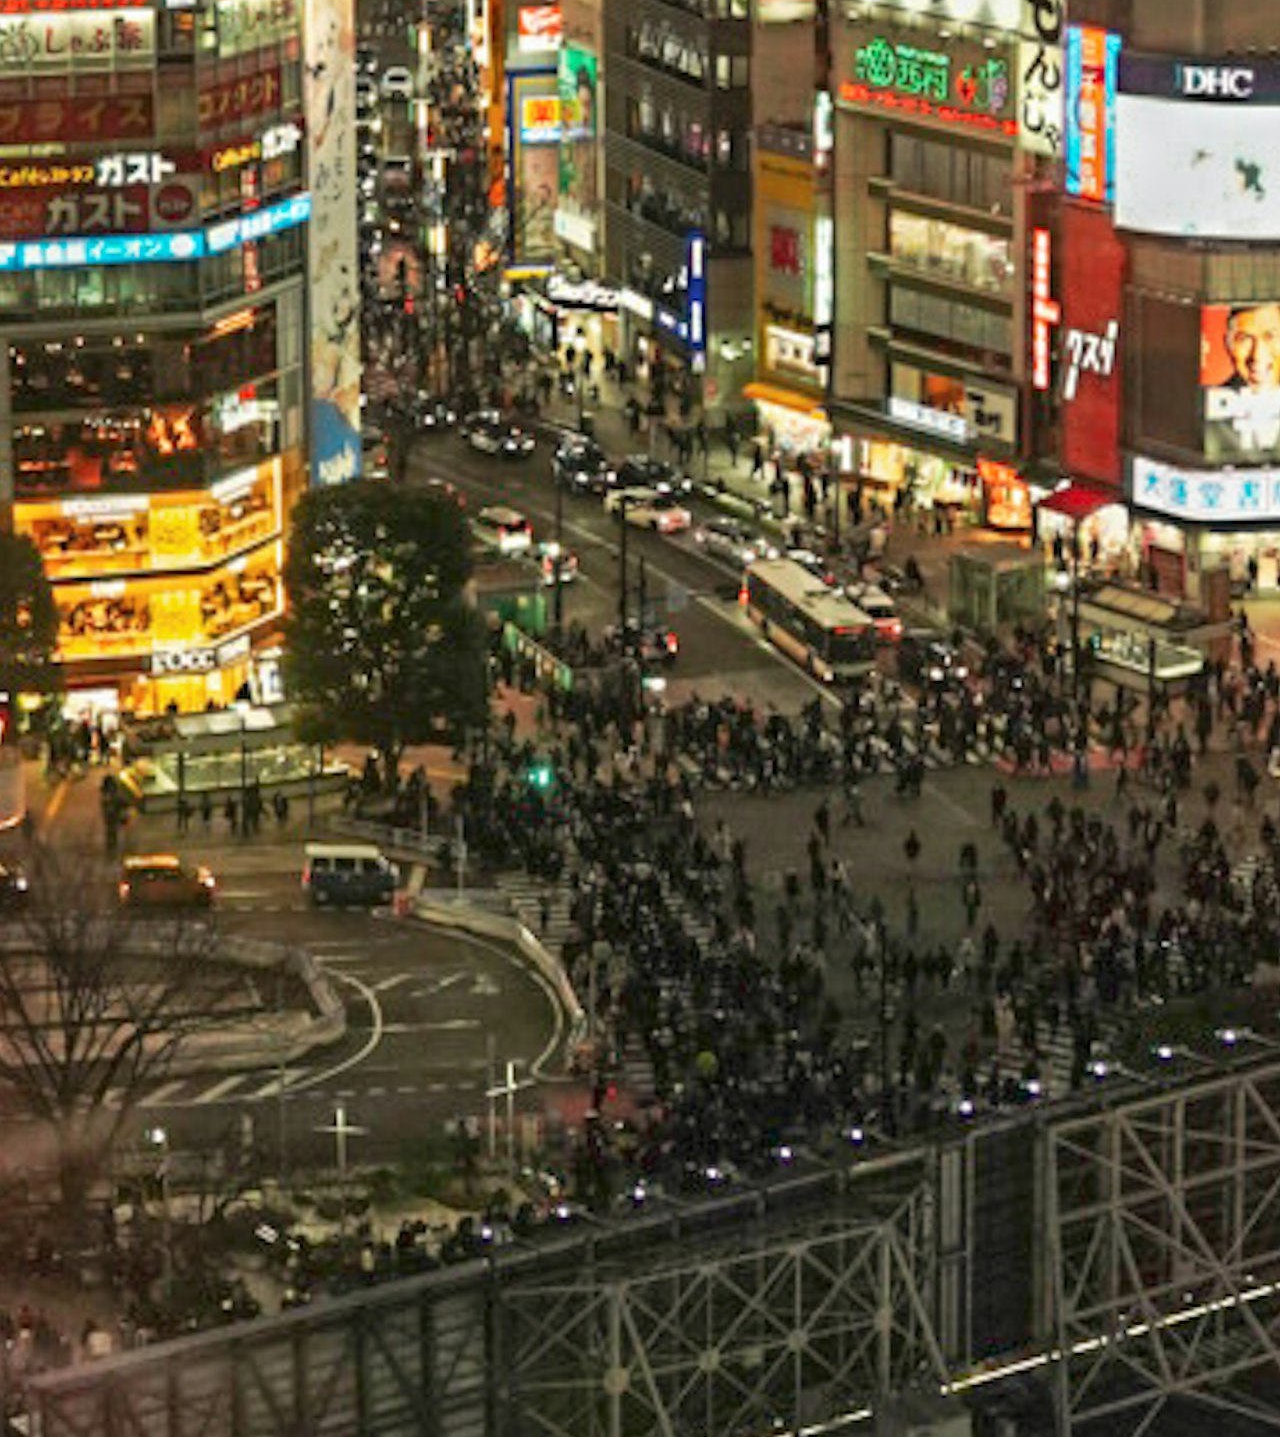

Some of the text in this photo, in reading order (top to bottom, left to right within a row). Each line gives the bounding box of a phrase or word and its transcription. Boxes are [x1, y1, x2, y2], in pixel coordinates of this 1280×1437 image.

[1182, 65, 1254, 98] DHC
[96, 152, 177, 188] ガスト
[45, 193, 141, 233] ガスト
